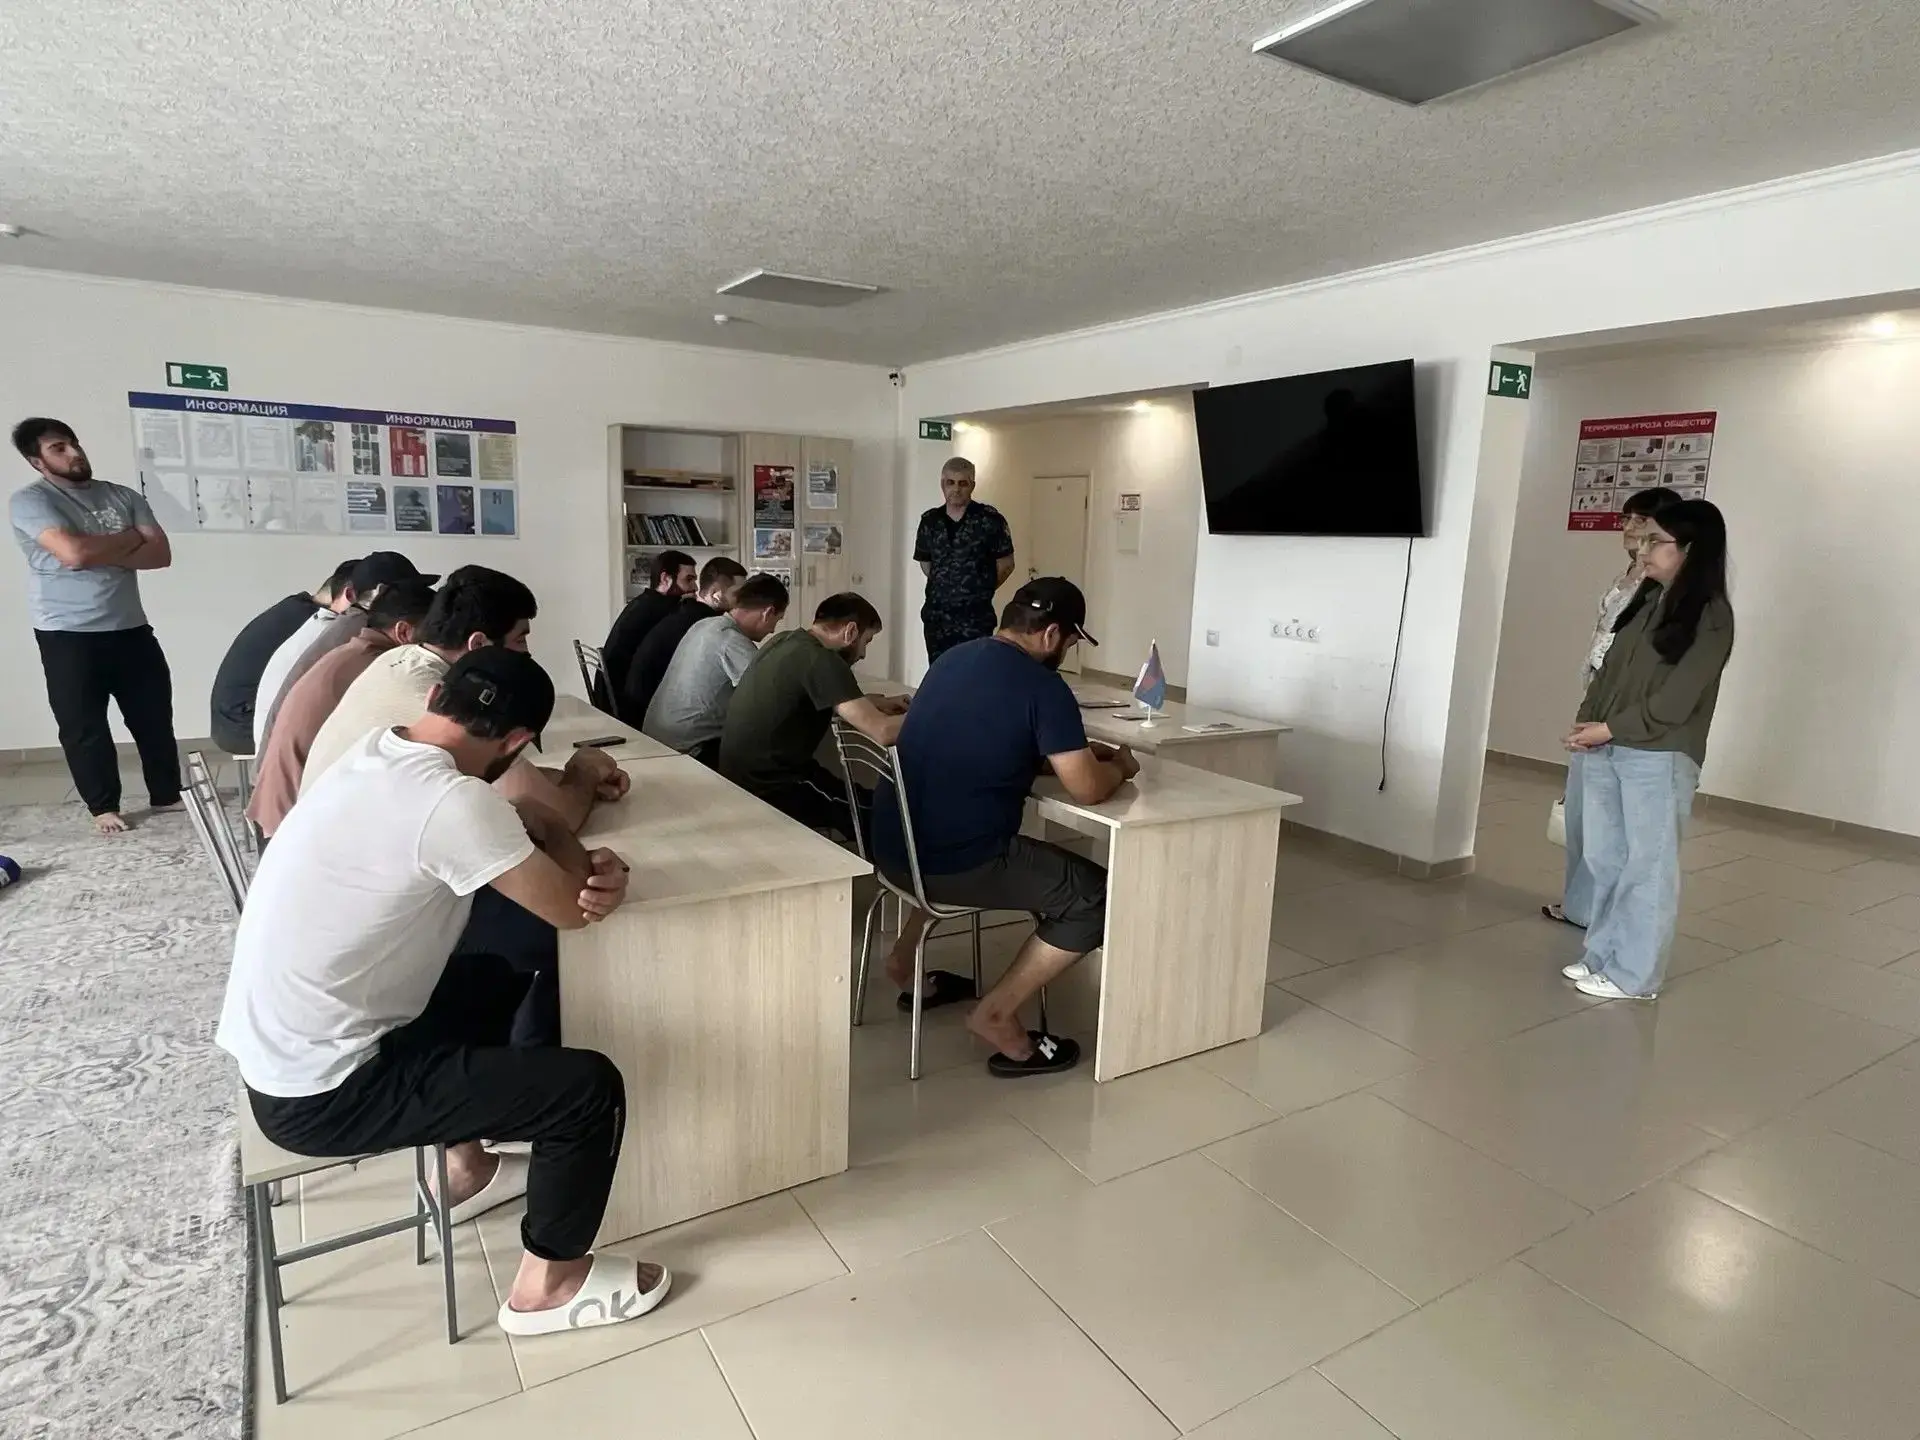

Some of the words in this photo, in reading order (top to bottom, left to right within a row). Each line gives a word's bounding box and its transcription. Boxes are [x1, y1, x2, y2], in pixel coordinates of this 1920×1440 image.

[185, 399, 289, 416] ИНФОРМАЦИЯ
[385, 413, 474, 429] ИНФОРМАЦИЯ
[1663, 417, 1713, 428] ОБЩЕСТВУ
